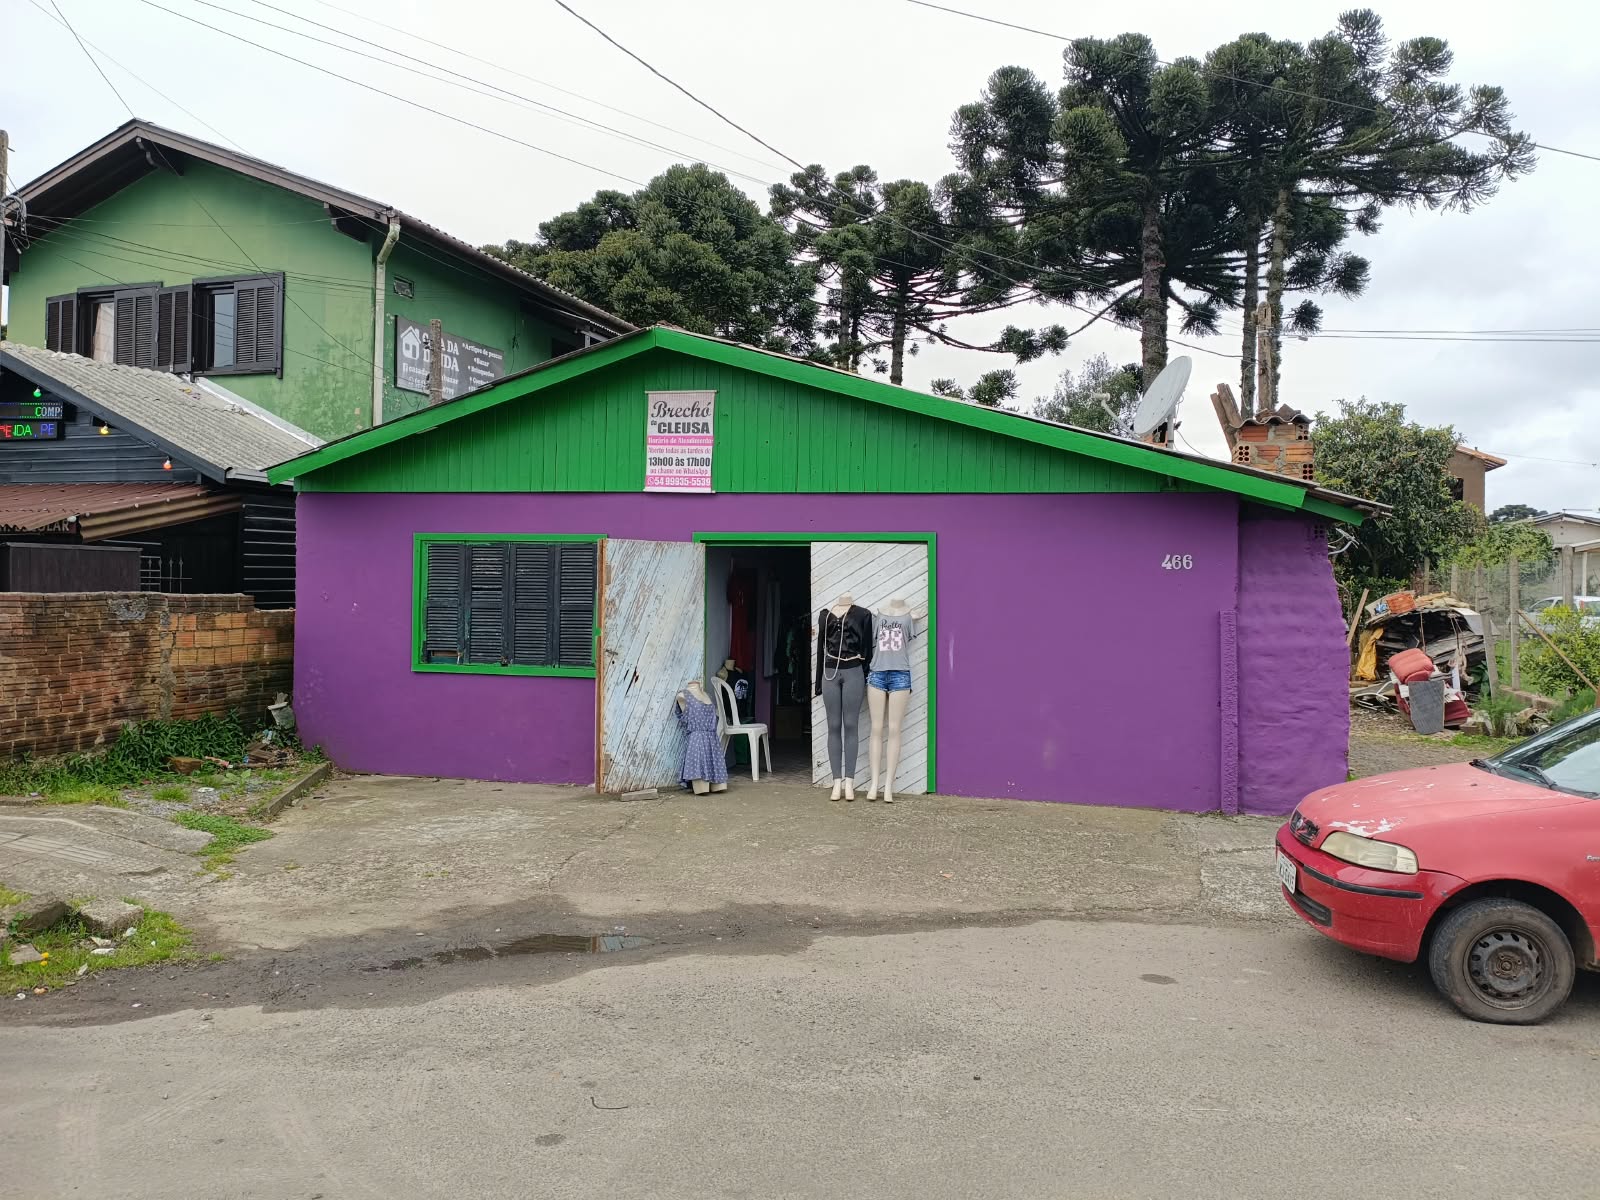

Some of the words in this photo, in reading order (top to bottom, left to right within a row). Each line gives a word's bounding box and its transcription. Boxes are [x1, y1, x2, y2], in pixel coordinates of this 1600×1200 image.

[651, 400, 712, 418] Brechó
[658, 422, 710, 434] CLEUSA
[648, 456, 674, 466] 13h00
[675, 456, 685, 466] às
[687, 457, 710, 467] 17h00
[654, 477, 664, 486] 54
[1161, 554, 1193, 570] 466
